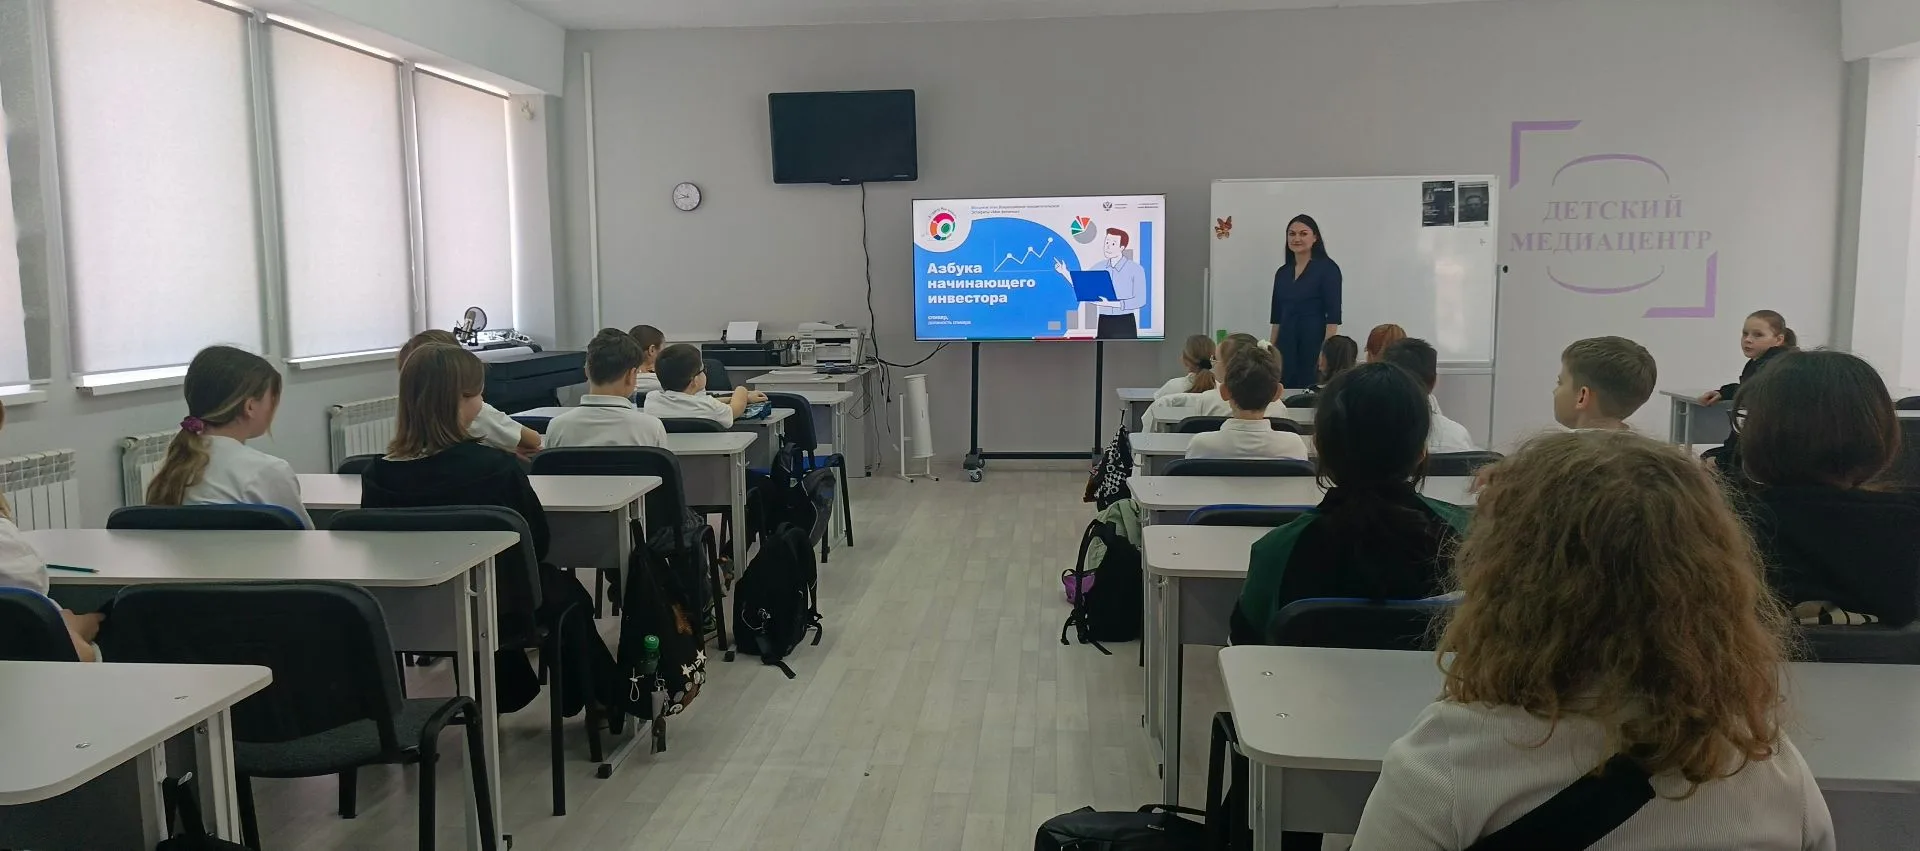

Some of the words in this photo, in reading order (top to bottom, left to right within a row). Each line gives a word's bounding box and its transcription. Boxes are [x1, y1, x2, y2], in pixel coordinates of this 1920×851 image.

[1542, 193, 1683, 223] ДЕТСКИЙ
[1510, 230, 1712, 254] МЕДИАЦЕНТР
[927, 262, 983, 276] Азбука
[927, 278, 1036, 290] начинающего
[928, 294, 1008, 305] инвестора
